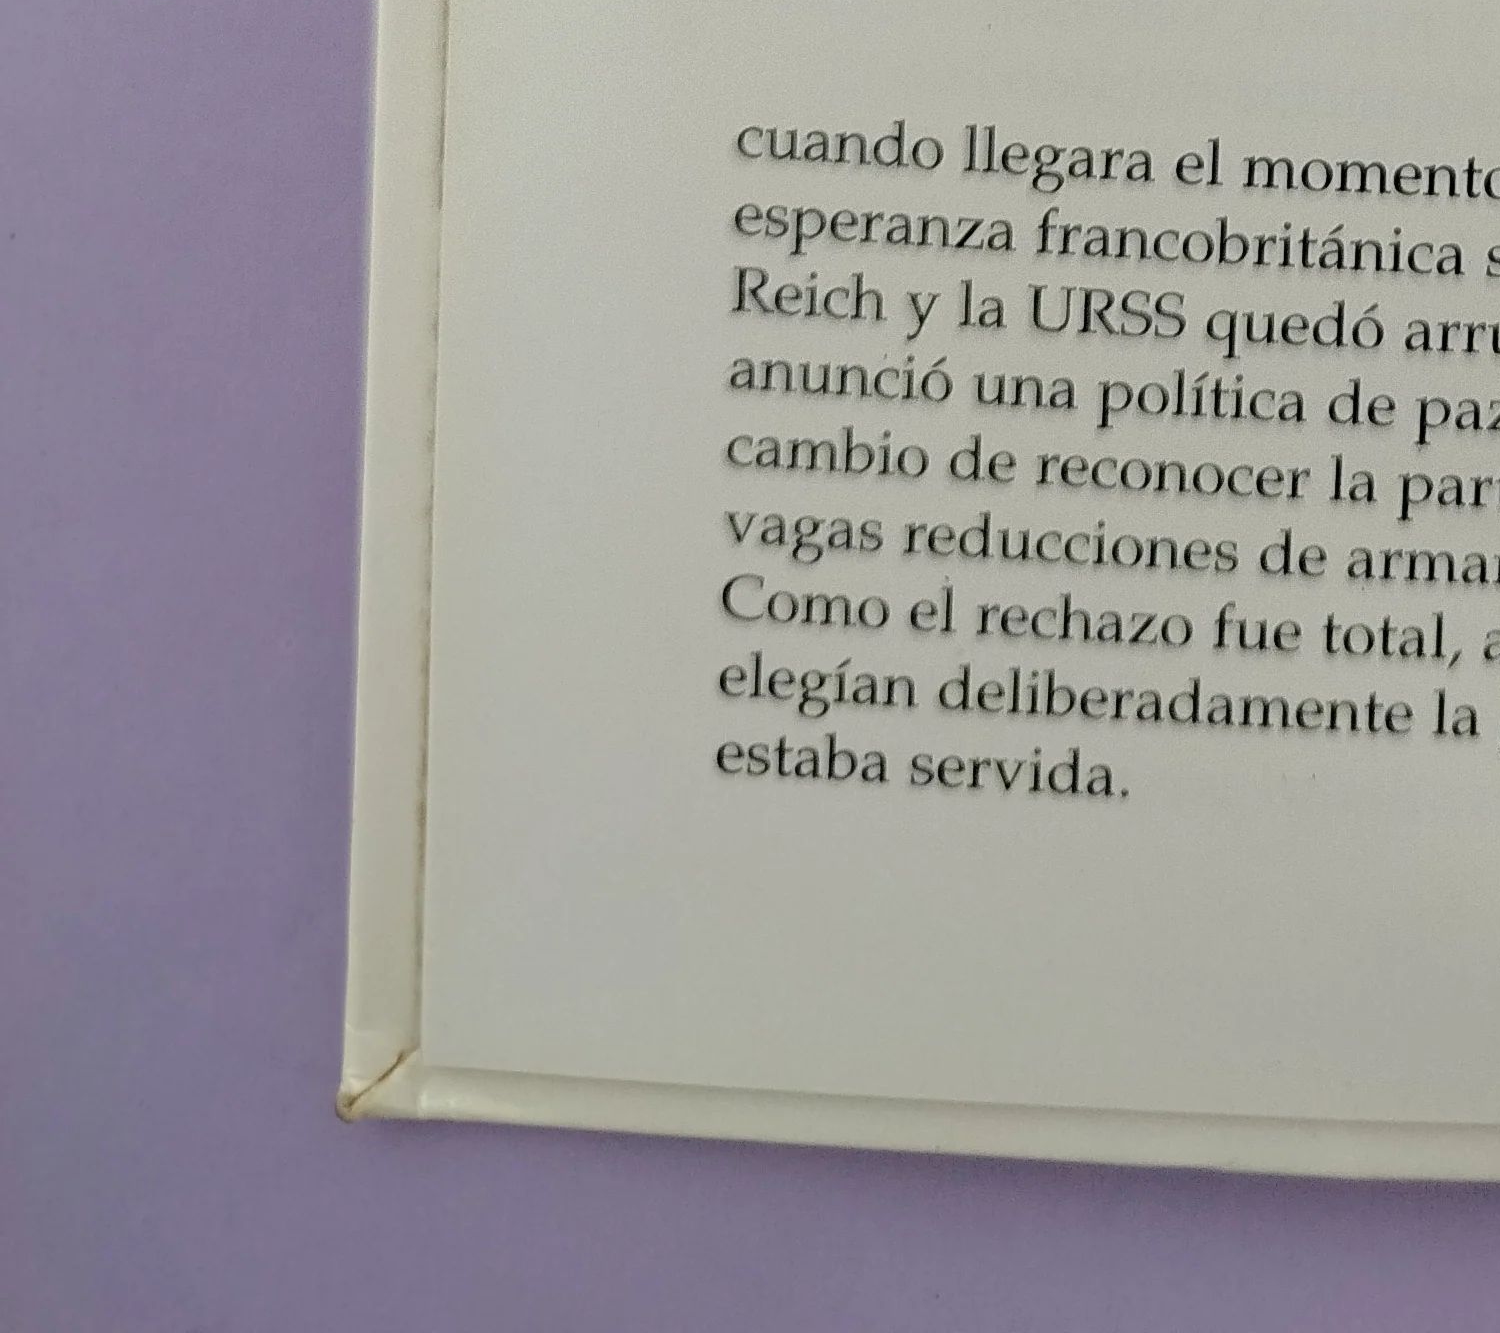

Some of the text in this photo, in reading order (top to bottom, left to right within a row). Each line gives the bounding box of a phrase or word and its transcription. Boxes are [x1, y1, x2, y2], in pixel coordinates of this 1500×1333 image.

[734, 119, 944, 172] cuando
[963, 124, 1155, 195] llegara
[1176, 137, 1223, 187] el
[732, 204, 1016, 258] esperanza
[1035, 207, 1465, 280] francobritánica
[731, 266, 887, 323] Reich
[907, 292, 941, 343] y
[958, 279, 1007, 331] la
[1028, 284, 1186, 341] URSS
[1206, 300, 1384, 363] quedó
[727, 355, 953, 405] anunció
[973, 374, 1078, 413] una
[1097, 368, 1306, 431] política
[1329, 378, 1396, 428] de
[725, 425, 929, 479] cambio
[949, 434, 1016, 485] de
[1036, 454, 1311, 502] reconocer
[1329, 454, 1377, 506] la
[724, 511, 883, 565] vagas
[903, 511, 1238, 575] reducciones
[1260, 528, 1327, 579] de
[720, 574, 890, 630] Como
[910, 585, 956, 635] el
[976, 593, 1193, 648] rechazo
[1213, 601, 1301, 655] fue
[1322, 611, 1462, 669] total,
[718, 651, 917, 719] elegían
[938, 664, 1413, 737] deliberadamente
[1432, 688, 1480, 740] la
[715, 733, 1129, 800] estaba servida.
